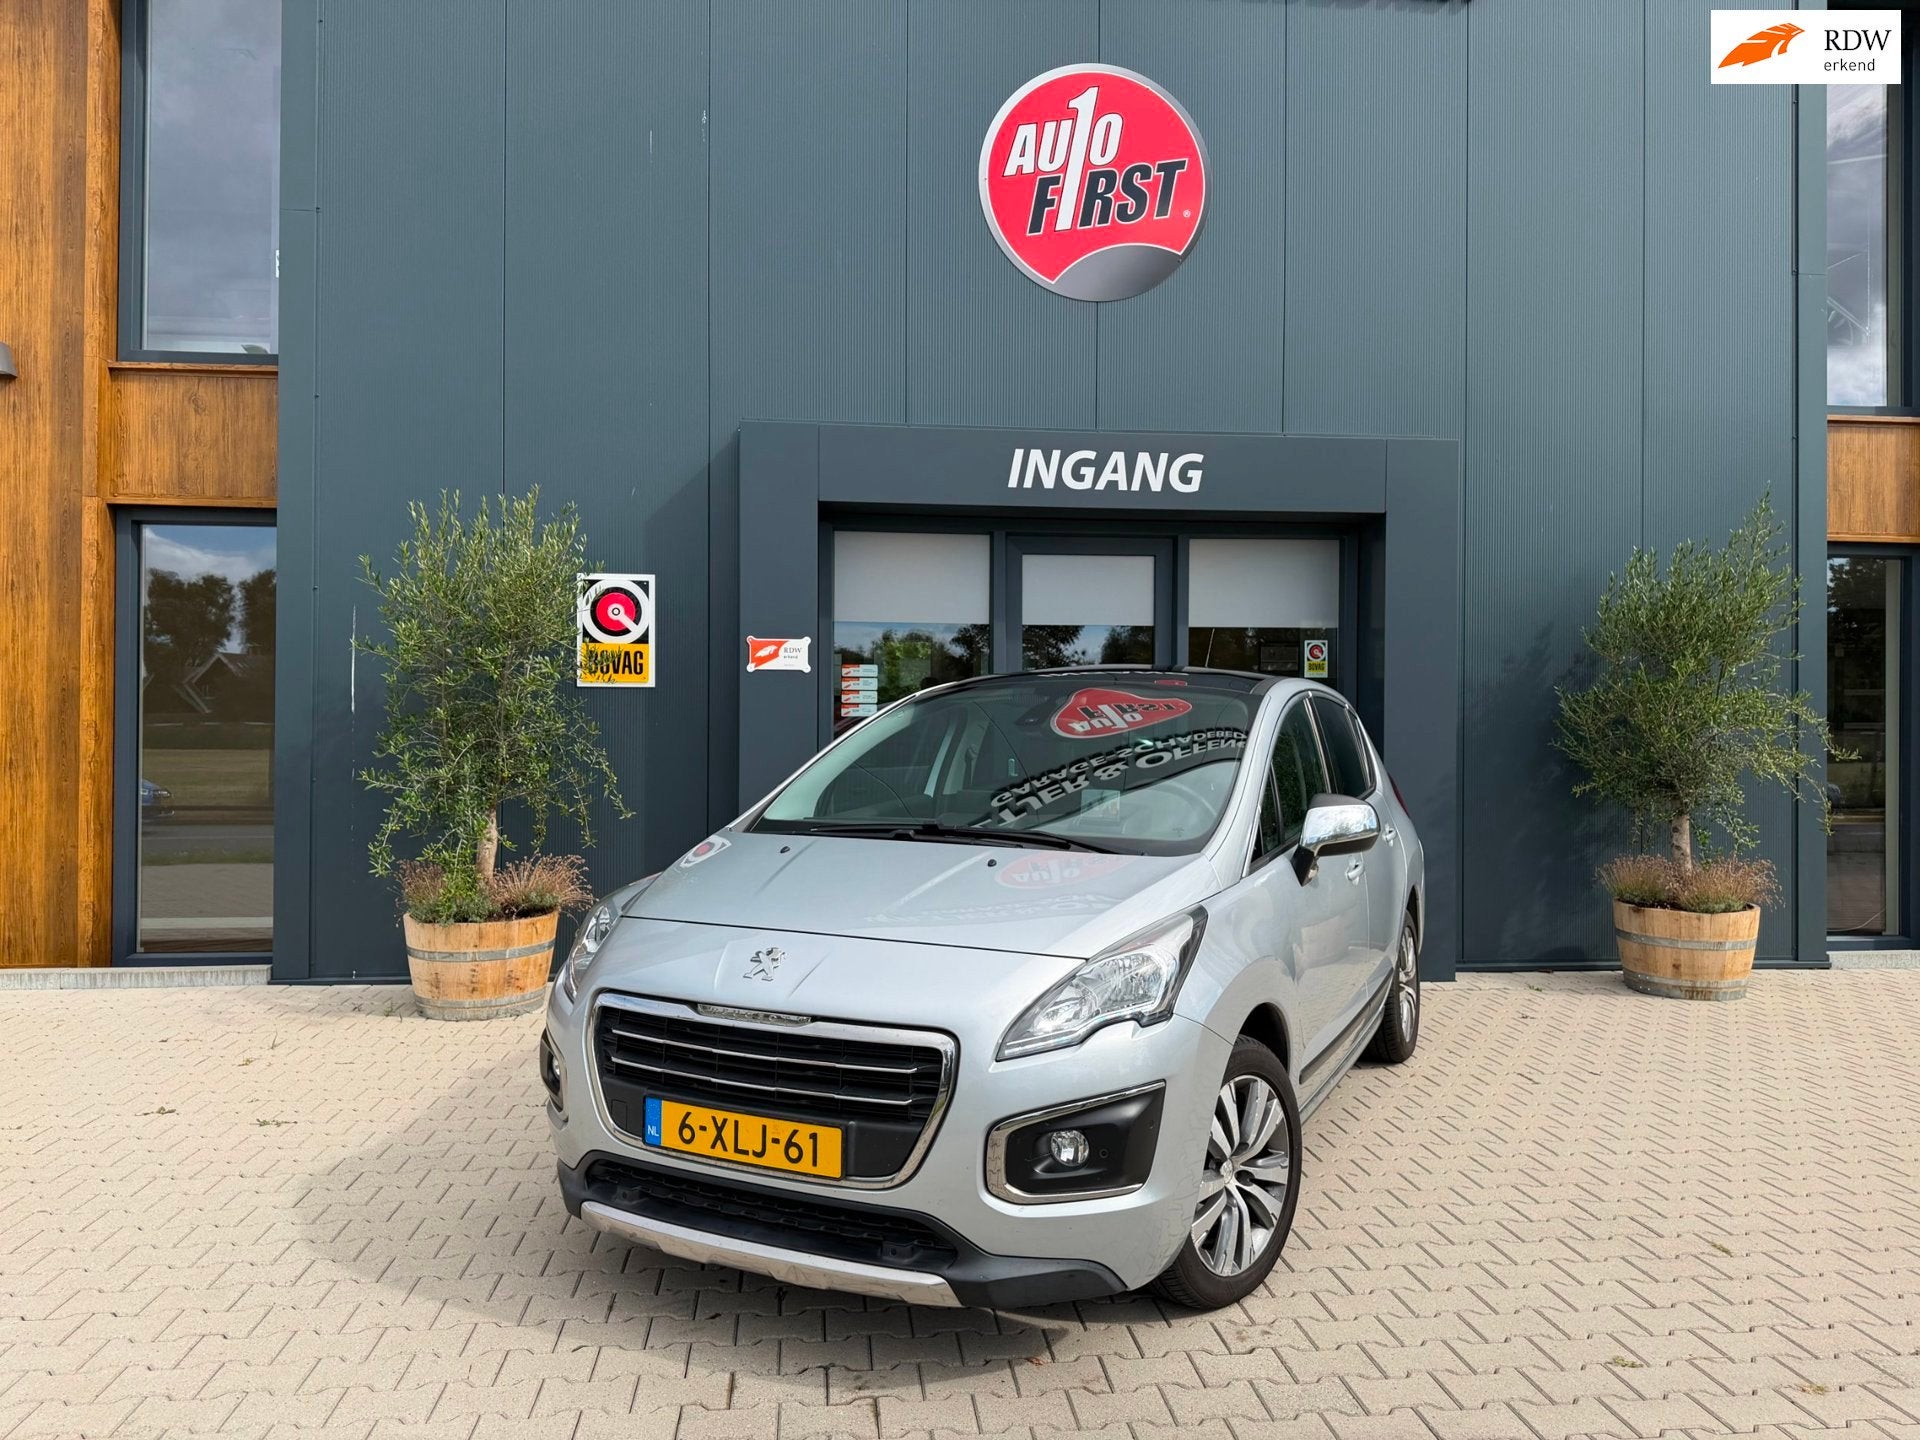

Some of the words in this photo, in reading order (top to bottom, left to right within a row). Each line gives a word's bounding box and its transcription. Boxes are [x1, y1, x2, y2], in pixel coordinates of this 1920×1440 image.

[1007, 448, 1205, 493] INGANG
[783, 646, 803, 654] RDW
[647, 1124, 660, 1137] NL
[678, 1111, 818, 1168] 6-XLJ-61
